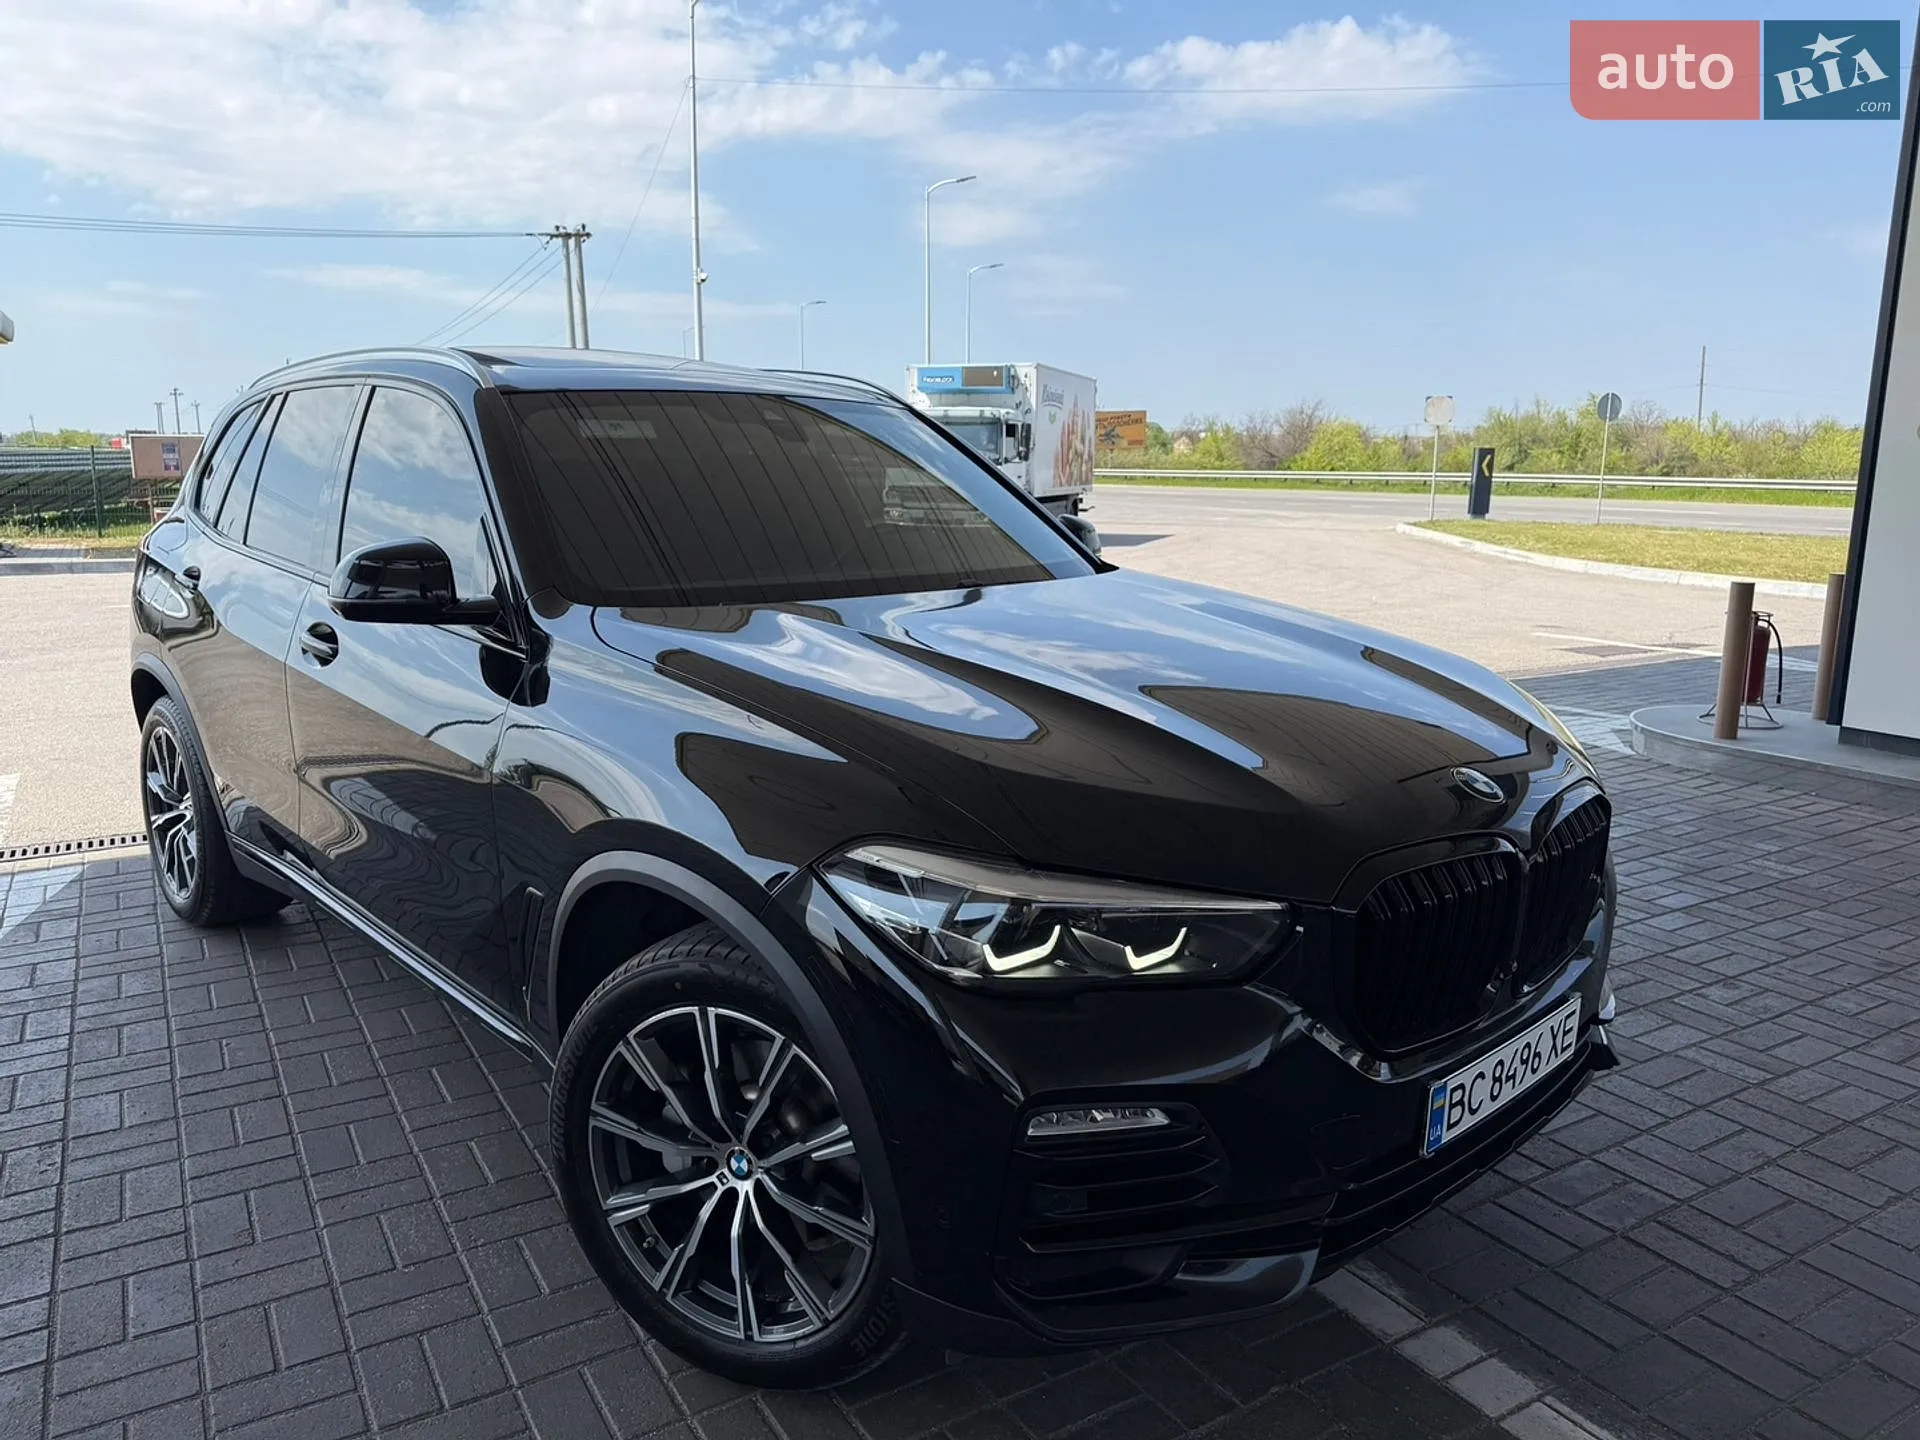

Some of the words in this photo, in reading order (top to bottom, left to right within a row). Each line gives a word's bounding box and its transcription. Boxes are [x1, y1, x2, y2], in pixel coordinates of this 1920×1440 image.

[1446, 1070, 1486, 1132] BC
[1489, 1031, 1545, 1102] 8496
[1545, 1009, 1577, 1066] XE
[1429, 1123, 1441, 1141] UA
